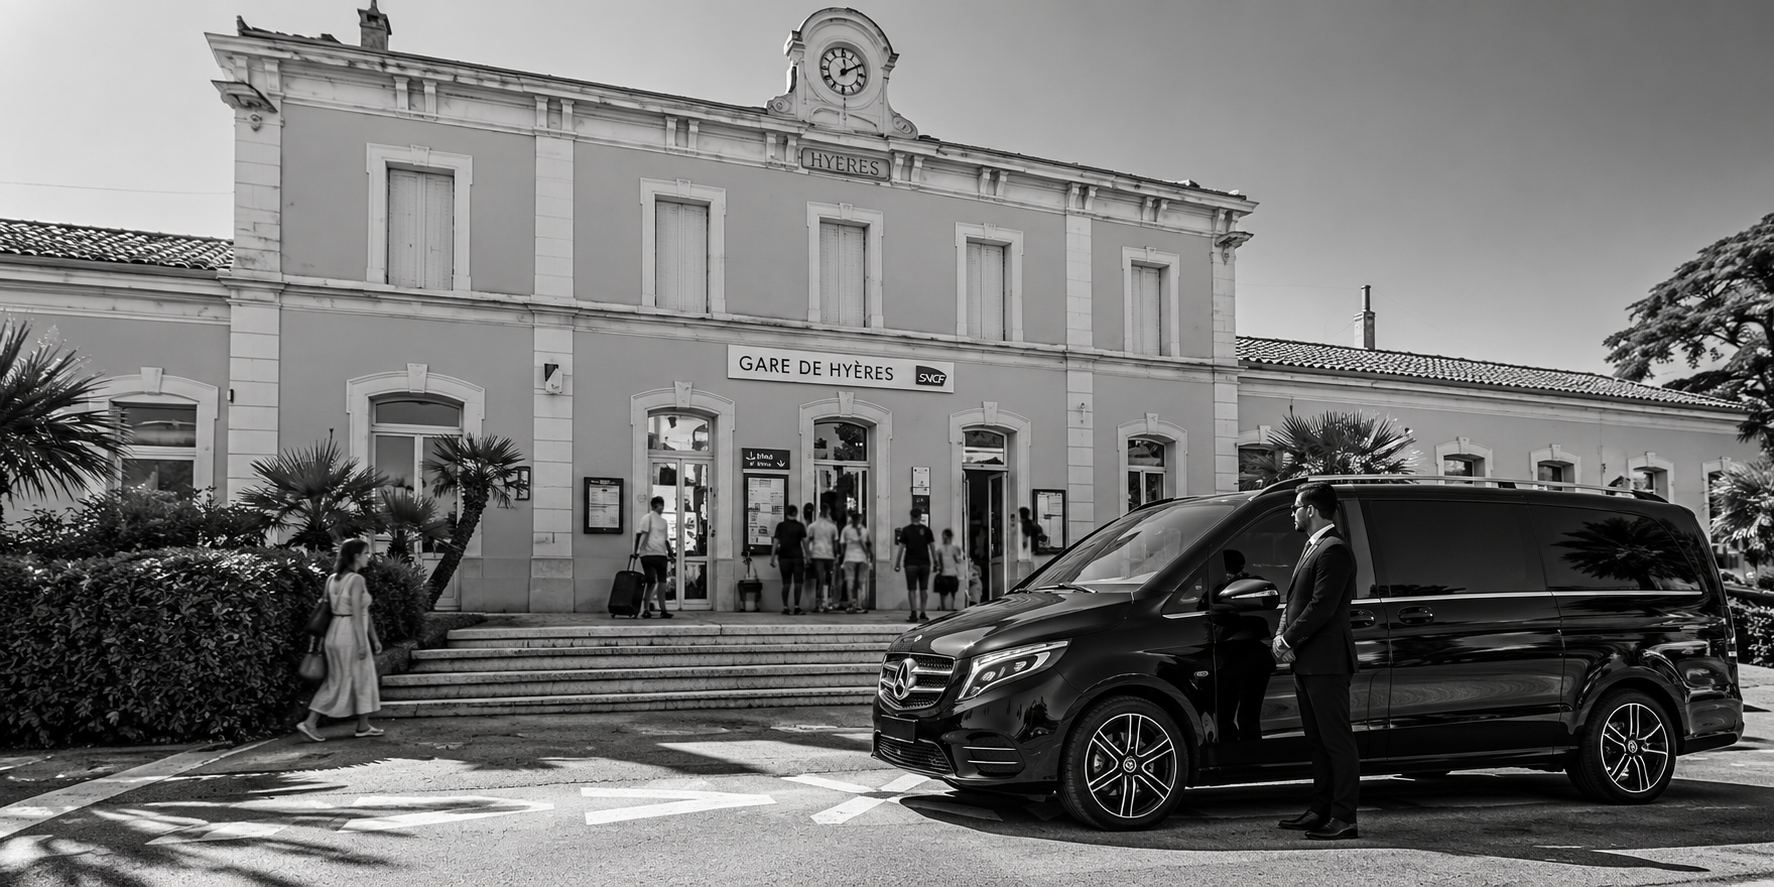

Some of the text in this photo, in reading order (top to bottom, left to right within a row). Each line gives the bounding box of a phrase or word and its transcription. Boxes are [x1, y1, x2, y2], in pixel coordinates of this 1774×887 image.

[739, 355, 894, 381] GARE DE HYÈRES
[918, 373, 946, 384] SNCF
